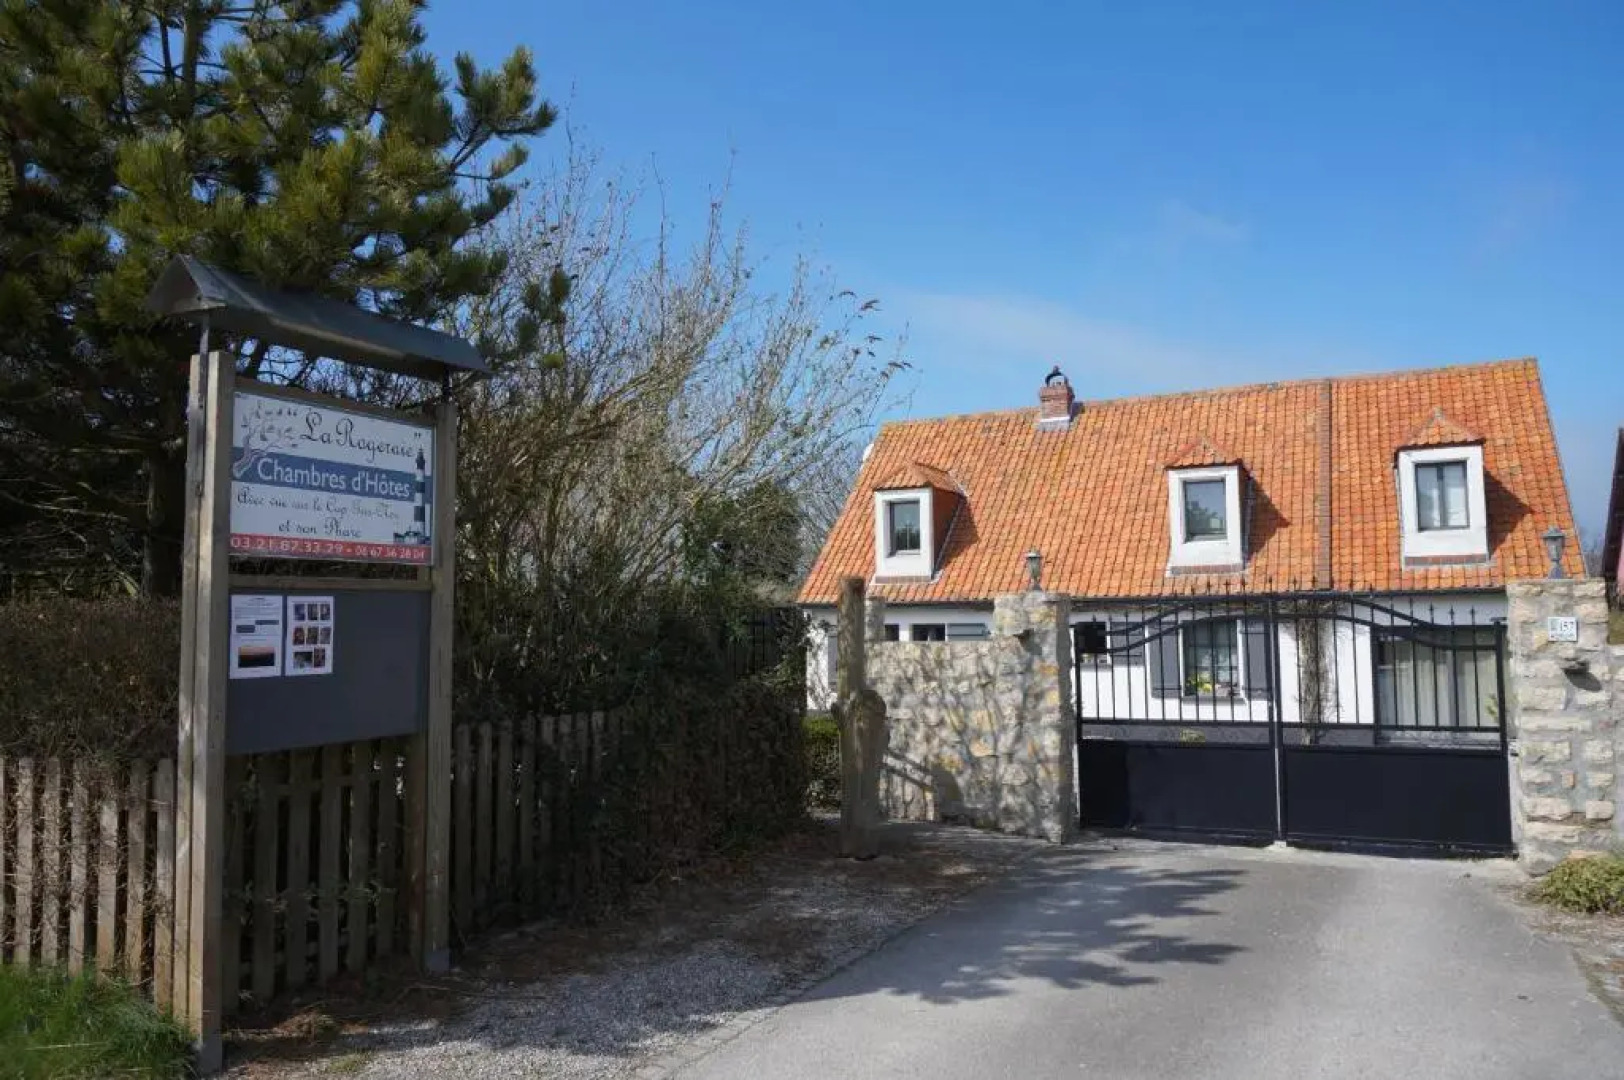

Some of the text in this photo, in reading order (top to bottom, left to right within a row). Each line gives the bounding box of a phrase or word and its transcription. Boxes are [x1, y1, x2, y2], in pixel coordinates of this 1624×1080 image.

[257, 457, 410, 498] Chambres d'Hôtes
[269, 497, 287, 509] vue
[312, 496, 323, 512] le
[326, 494, 348, 519] Cap
[278, 516, 362, 538] et son Phare
